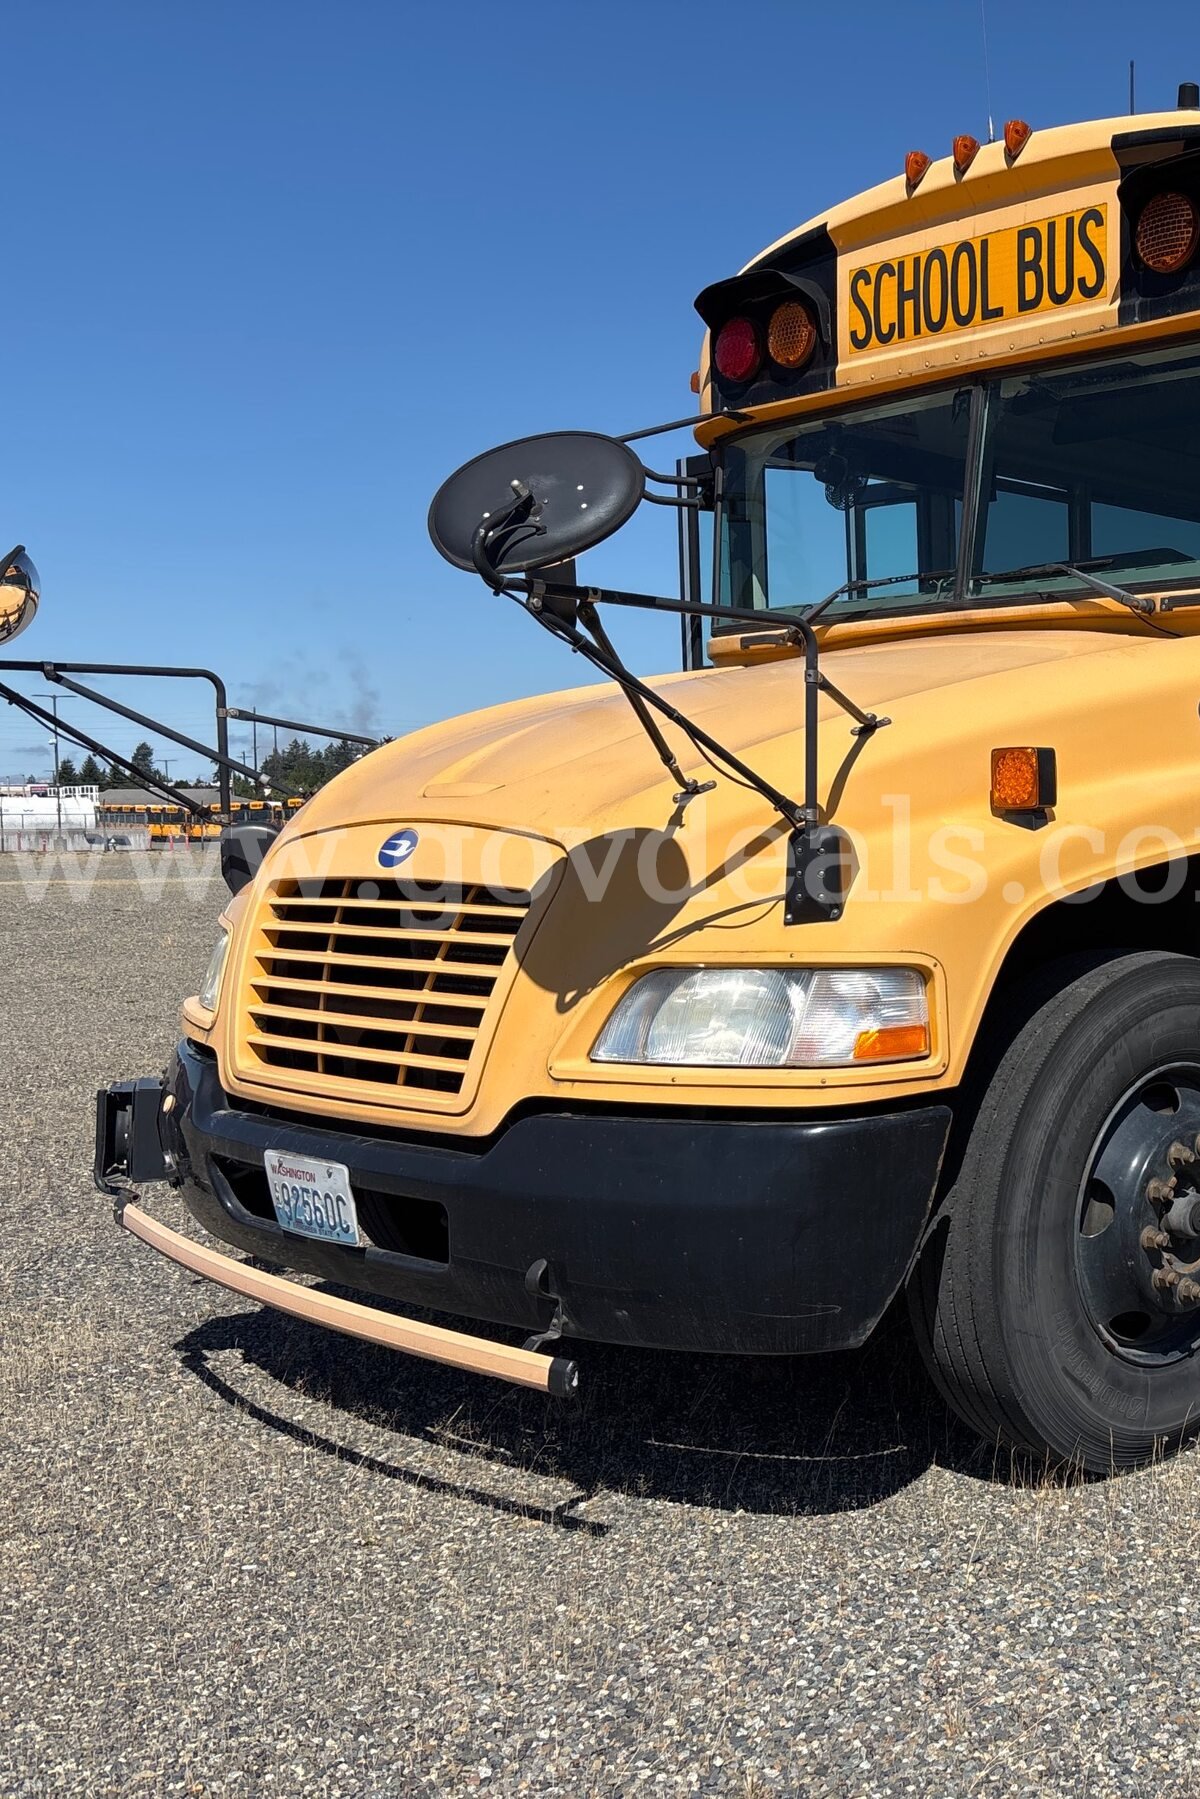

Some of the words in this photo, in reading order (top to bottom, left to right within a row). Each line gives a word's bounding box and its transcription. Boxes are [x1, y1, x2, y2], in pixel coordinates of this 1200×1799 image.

[850, 239, 1004, 350] SCHOOL
[1017, 208, 1105, 313] BUS
[270, 1164, 316, 1184] WASHINGTON
[281, 1182, 351, 1234] 92560C
